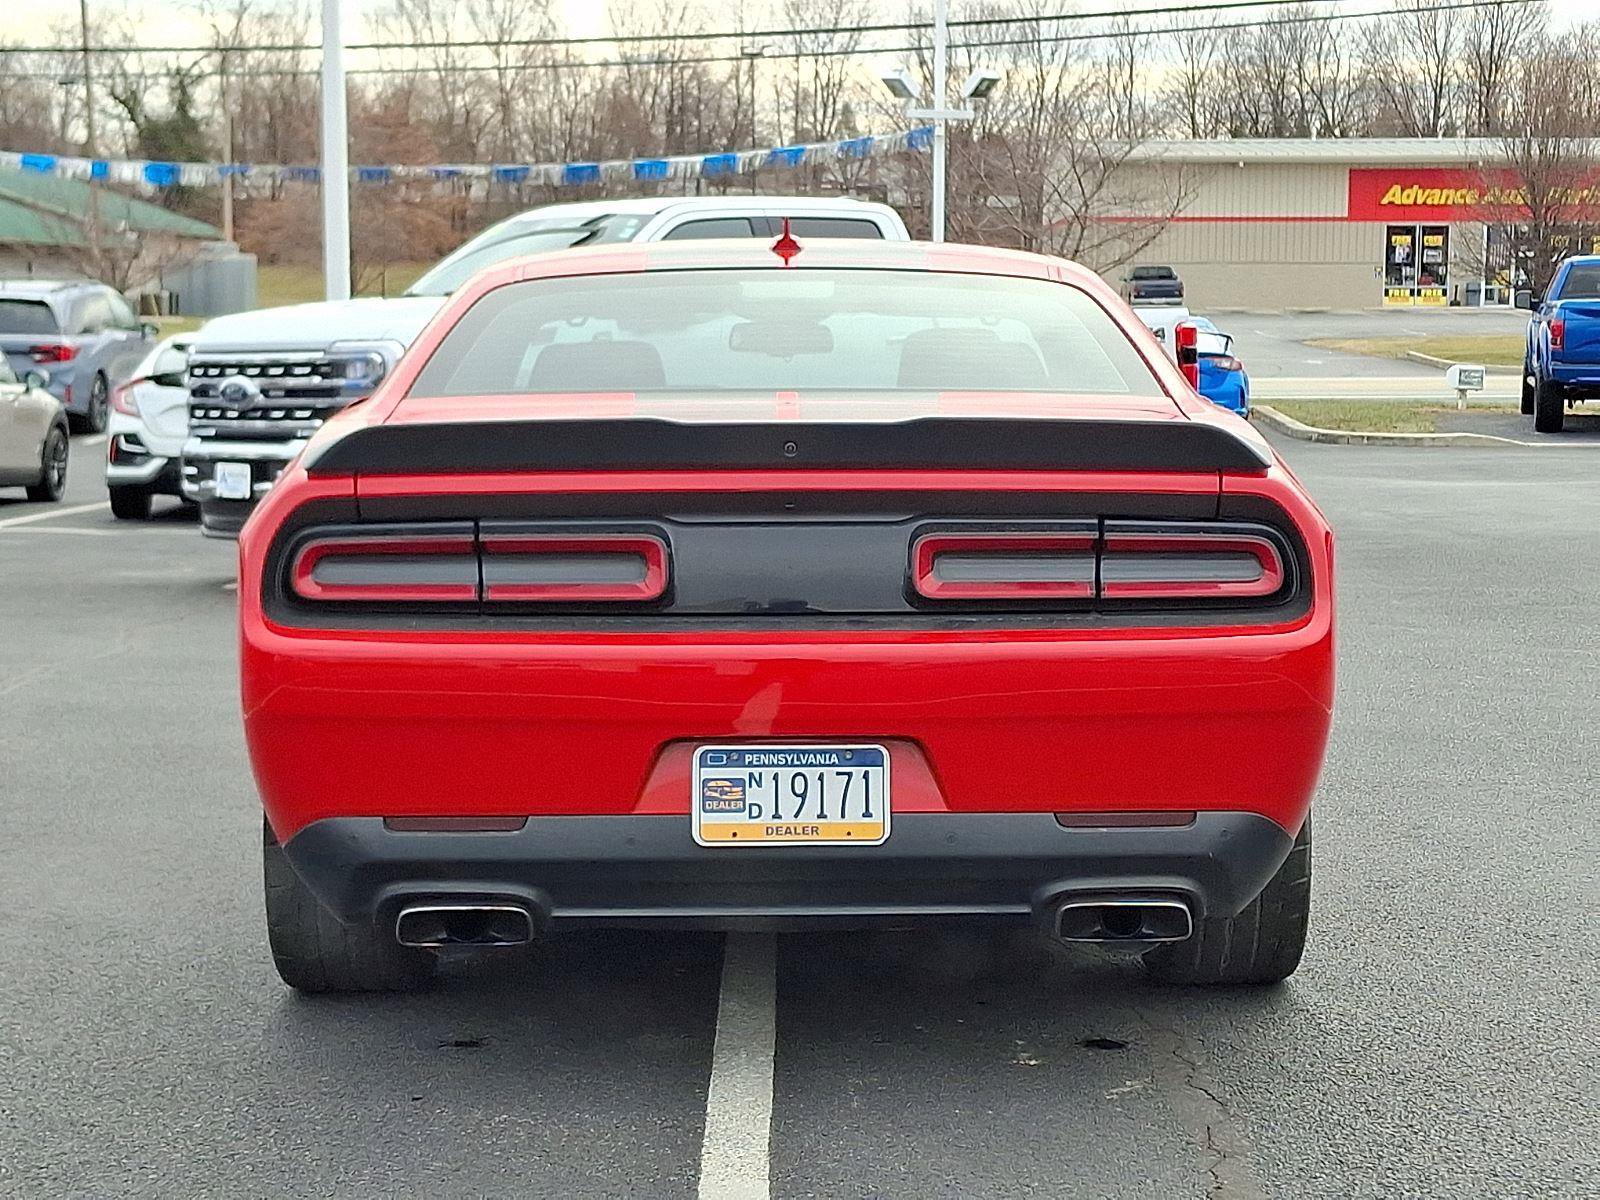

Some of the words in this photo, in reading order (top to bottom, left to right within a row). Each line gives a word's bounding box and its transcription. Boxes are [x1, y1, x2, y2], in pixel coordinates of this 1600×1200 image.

[1380, 184, 1479, 205] Advance
[744, 753, 839, 766] PENNSYLVANIA
[771, 770, 873, 819] 19171
[705, 800, 744, 810] DEALER
[765, 825, 820, 837] DEALER
